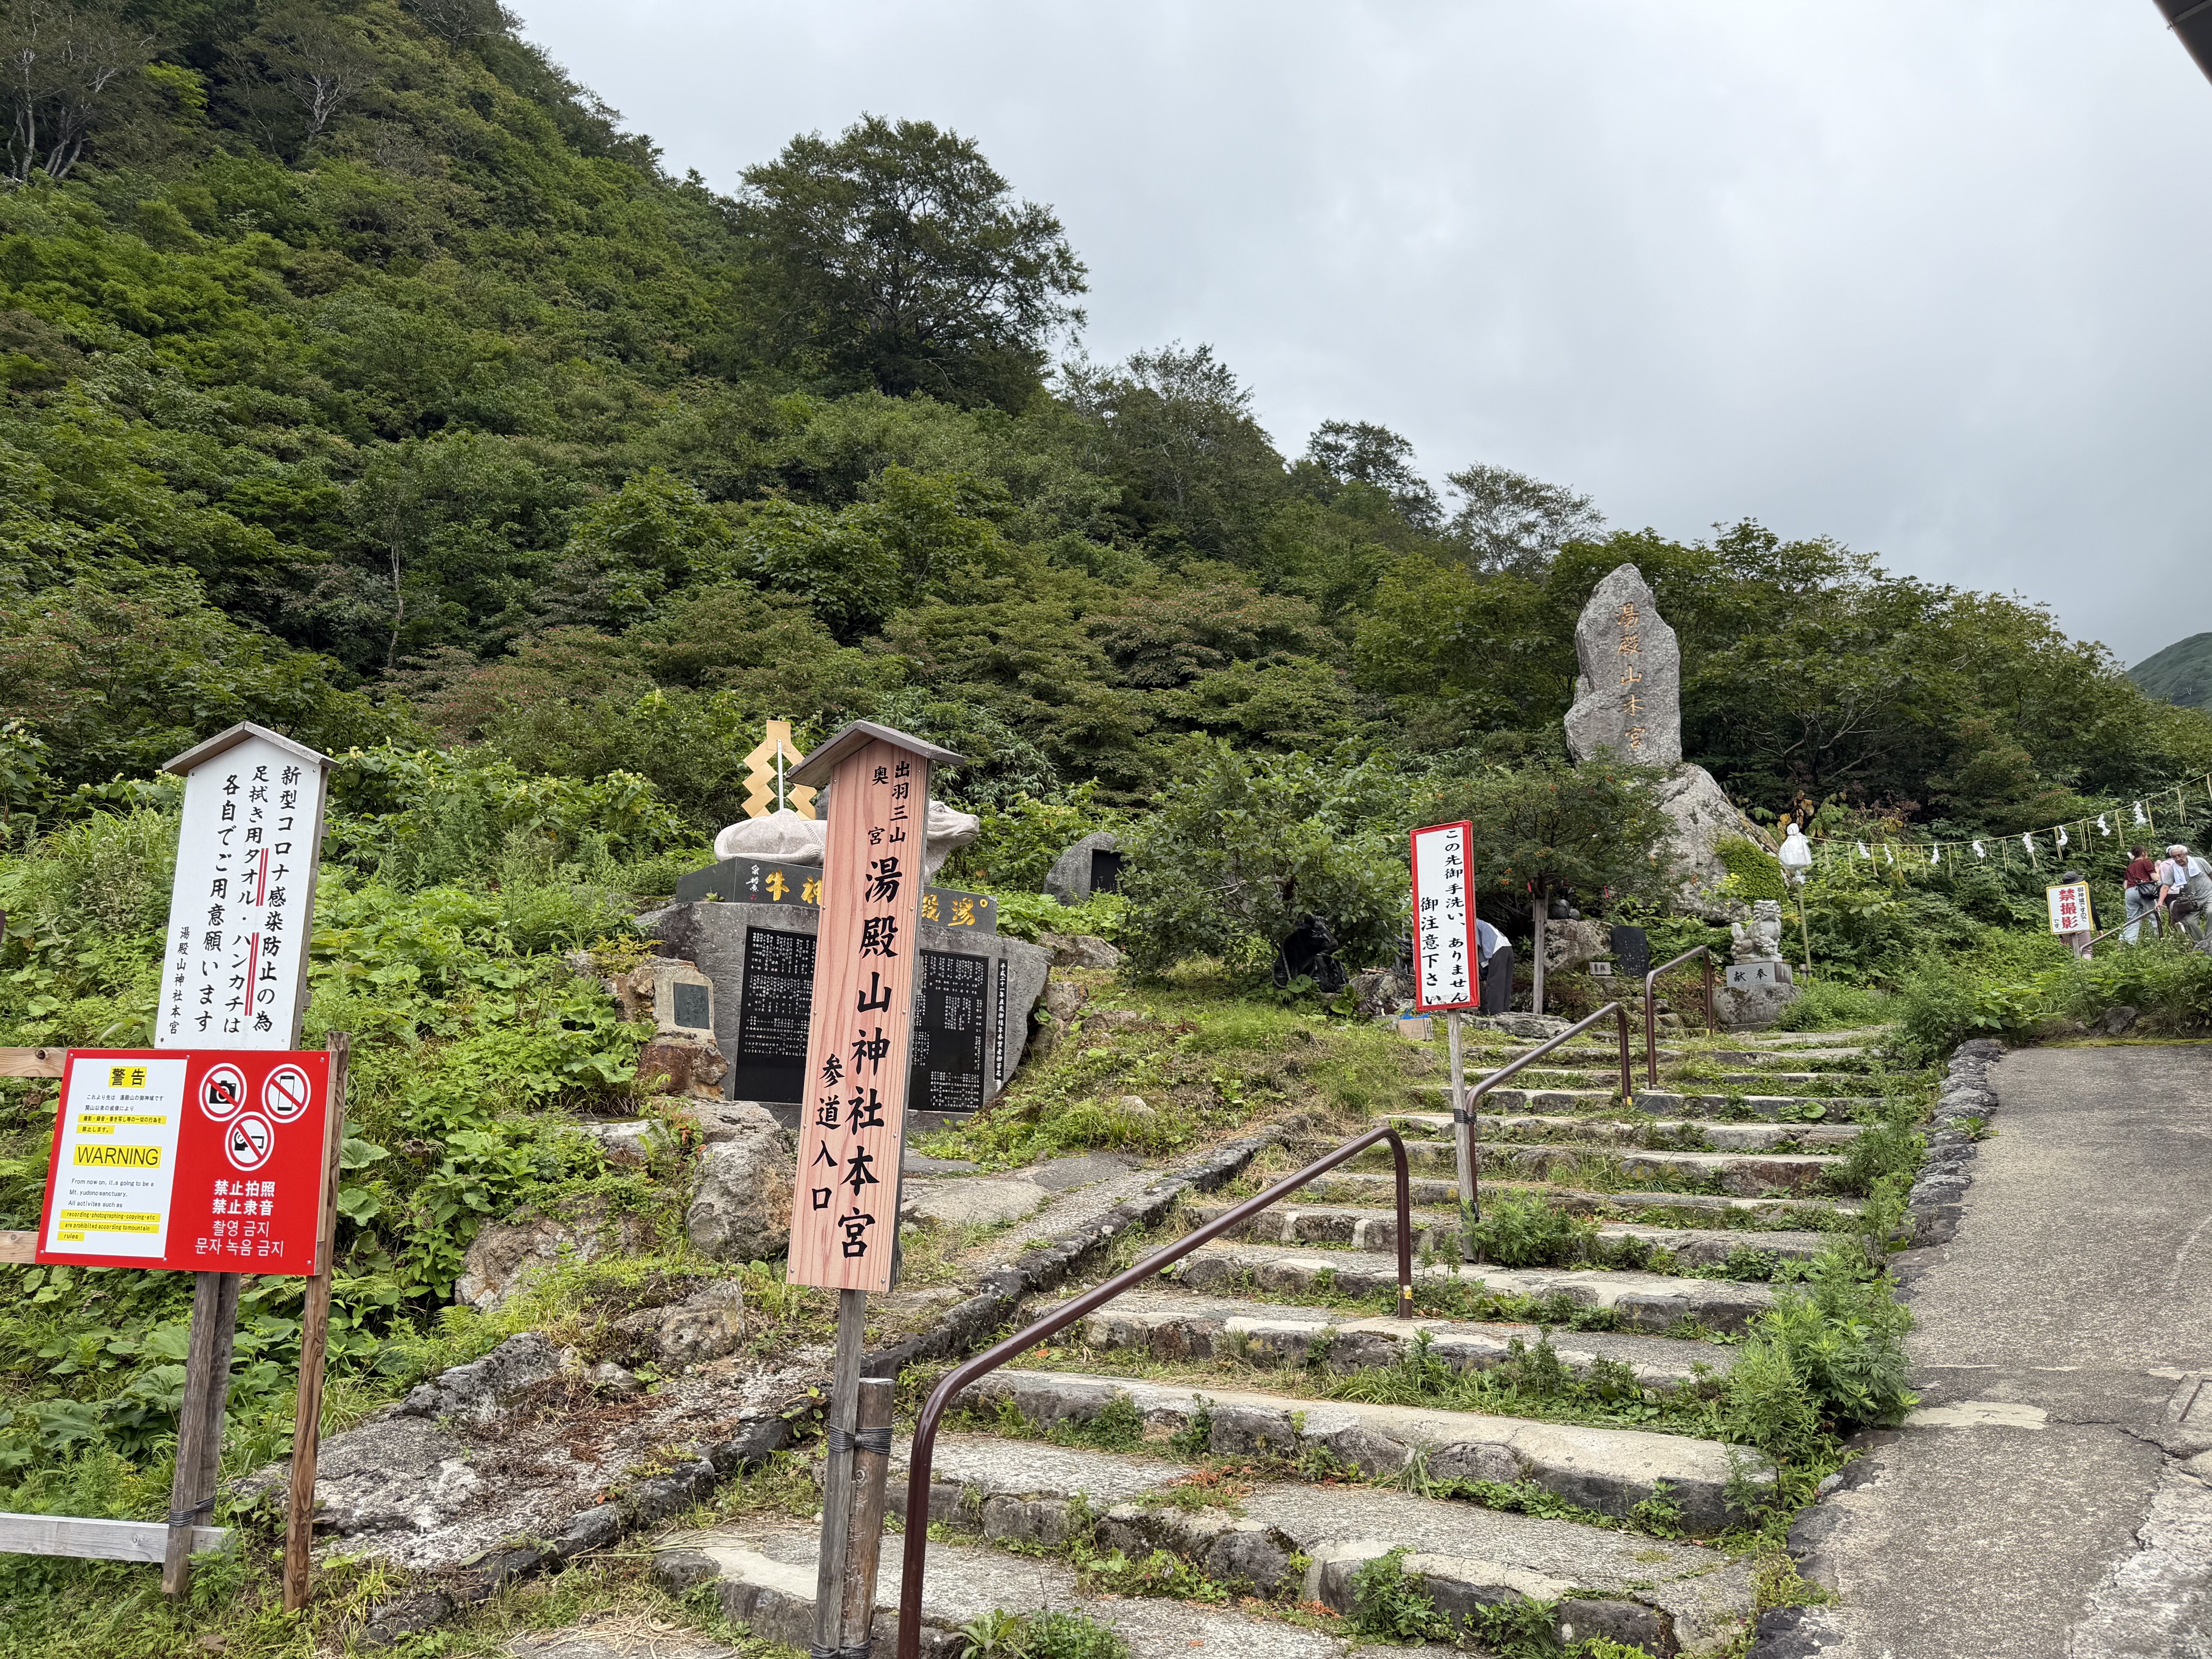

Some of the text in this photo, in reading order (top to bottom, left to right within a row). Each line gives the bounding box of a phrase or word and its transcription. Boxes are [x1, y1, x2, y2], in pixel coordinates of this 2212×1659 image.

[1615, 601, 1646, 748] 湯殿山本宮
[889, 761, 910, 843] 出羽三山
[194, 775, 240, 1032] 各自でご用意願います
[224, 765, 269, 1034] 足拭き用タオル・ハンカチは
[252, 765, 302, 1032] 新型コロナ感染防止の為
[2058, 888, 2078, 929] 禁撮影
[2077, 887, 2087, 922] 御神域ですので
[169, 926, 190, 1034] 湯殿山神社本宮
[1420, 897, 1441, 1005] 御注意下さい
[112, 1068, 145, 1086] 警告
[838, 856, 902, 1259] 湯殿山神社本宮
[78, 1147, 158, 1165] WARNING
[811, 1053, 845, 1211] 参道入口
[212, 1198, 273, 1216] 禁止隶音
[213, 1220, 269, 1238] 촬영 금지
[214, 1179, 275, 1197] 禁止拍照
[195, 1238, 283, 1257] 문자 녹음 금지
